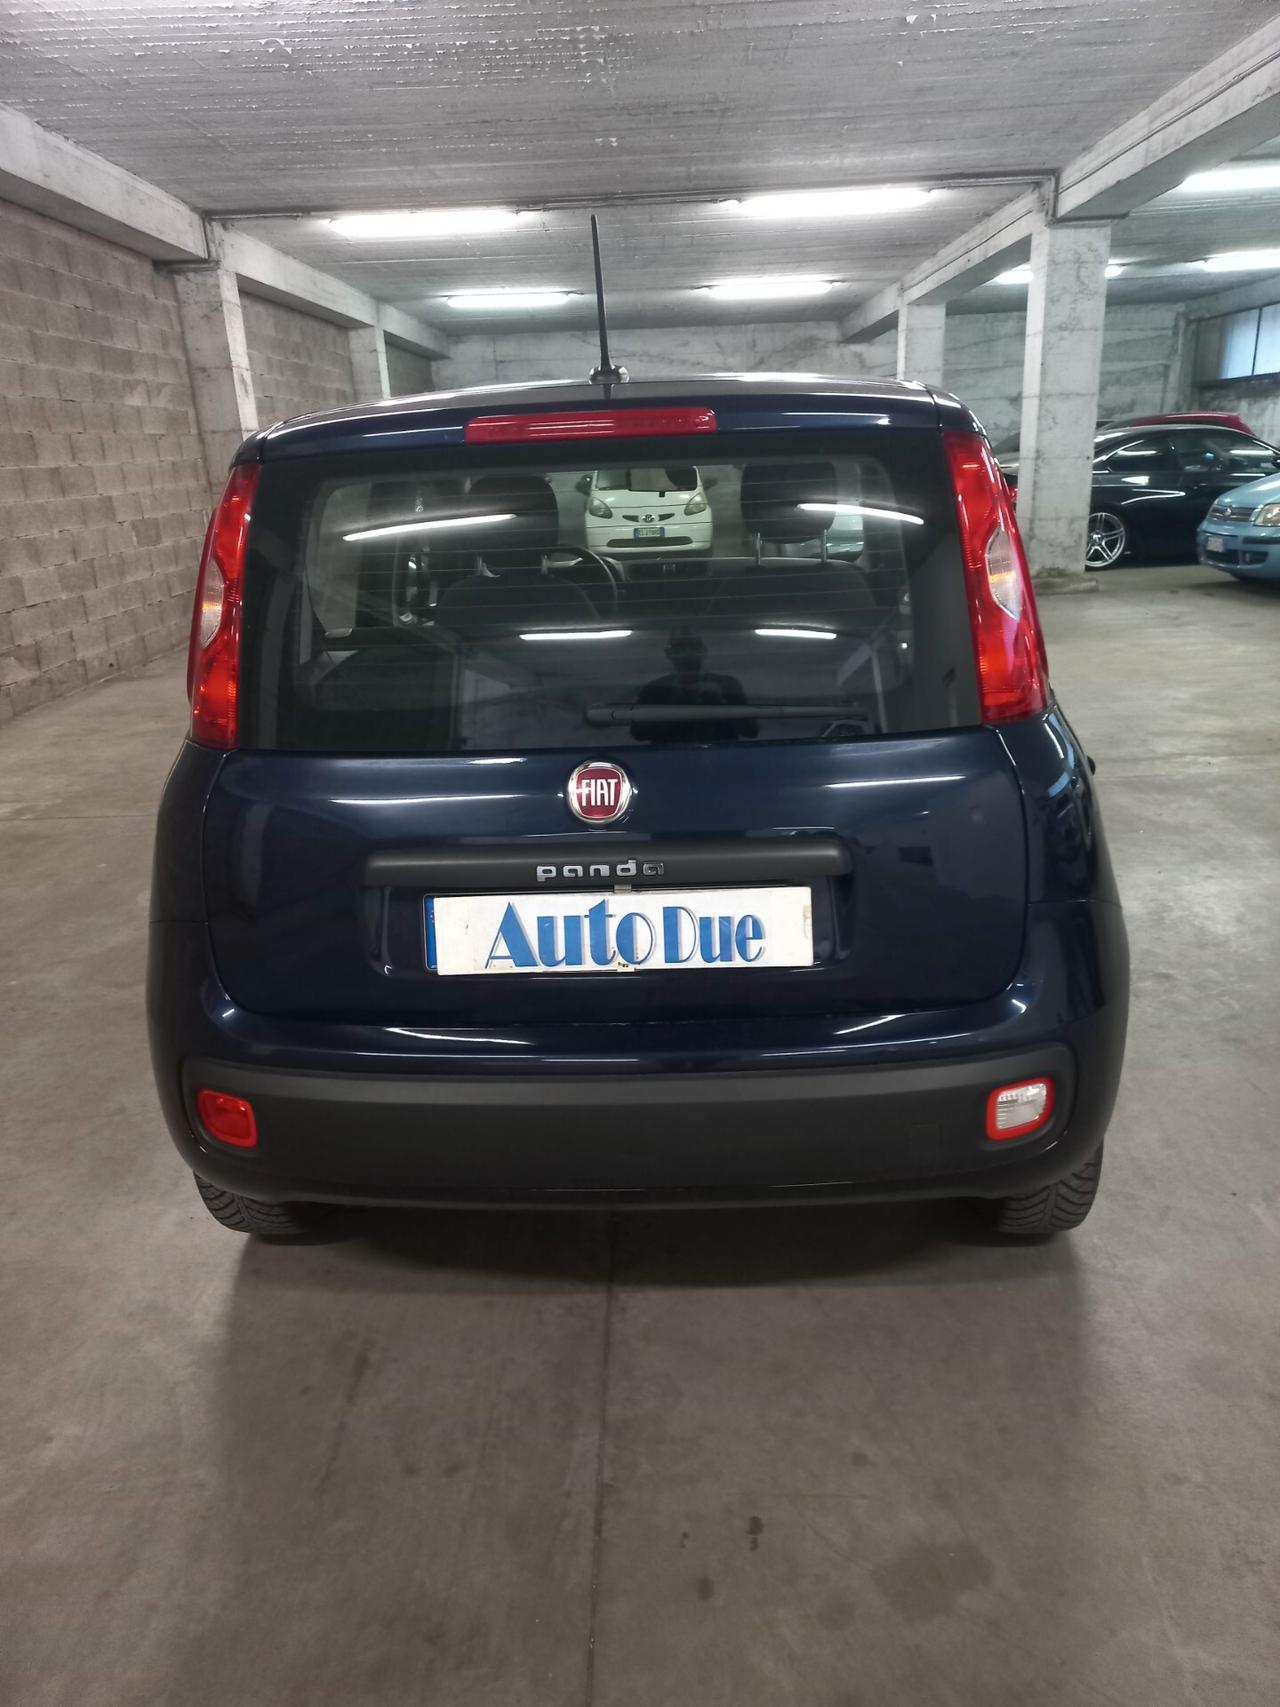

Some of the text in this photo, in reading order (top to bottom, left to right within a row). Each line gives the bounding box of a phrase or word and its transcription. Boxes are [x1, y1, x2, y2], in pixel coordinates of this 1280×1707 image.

[582, 778, 618, 806] FIAT
[536, 860, 664, 881] panda
[485, 899, 766, 968] Auto Due
